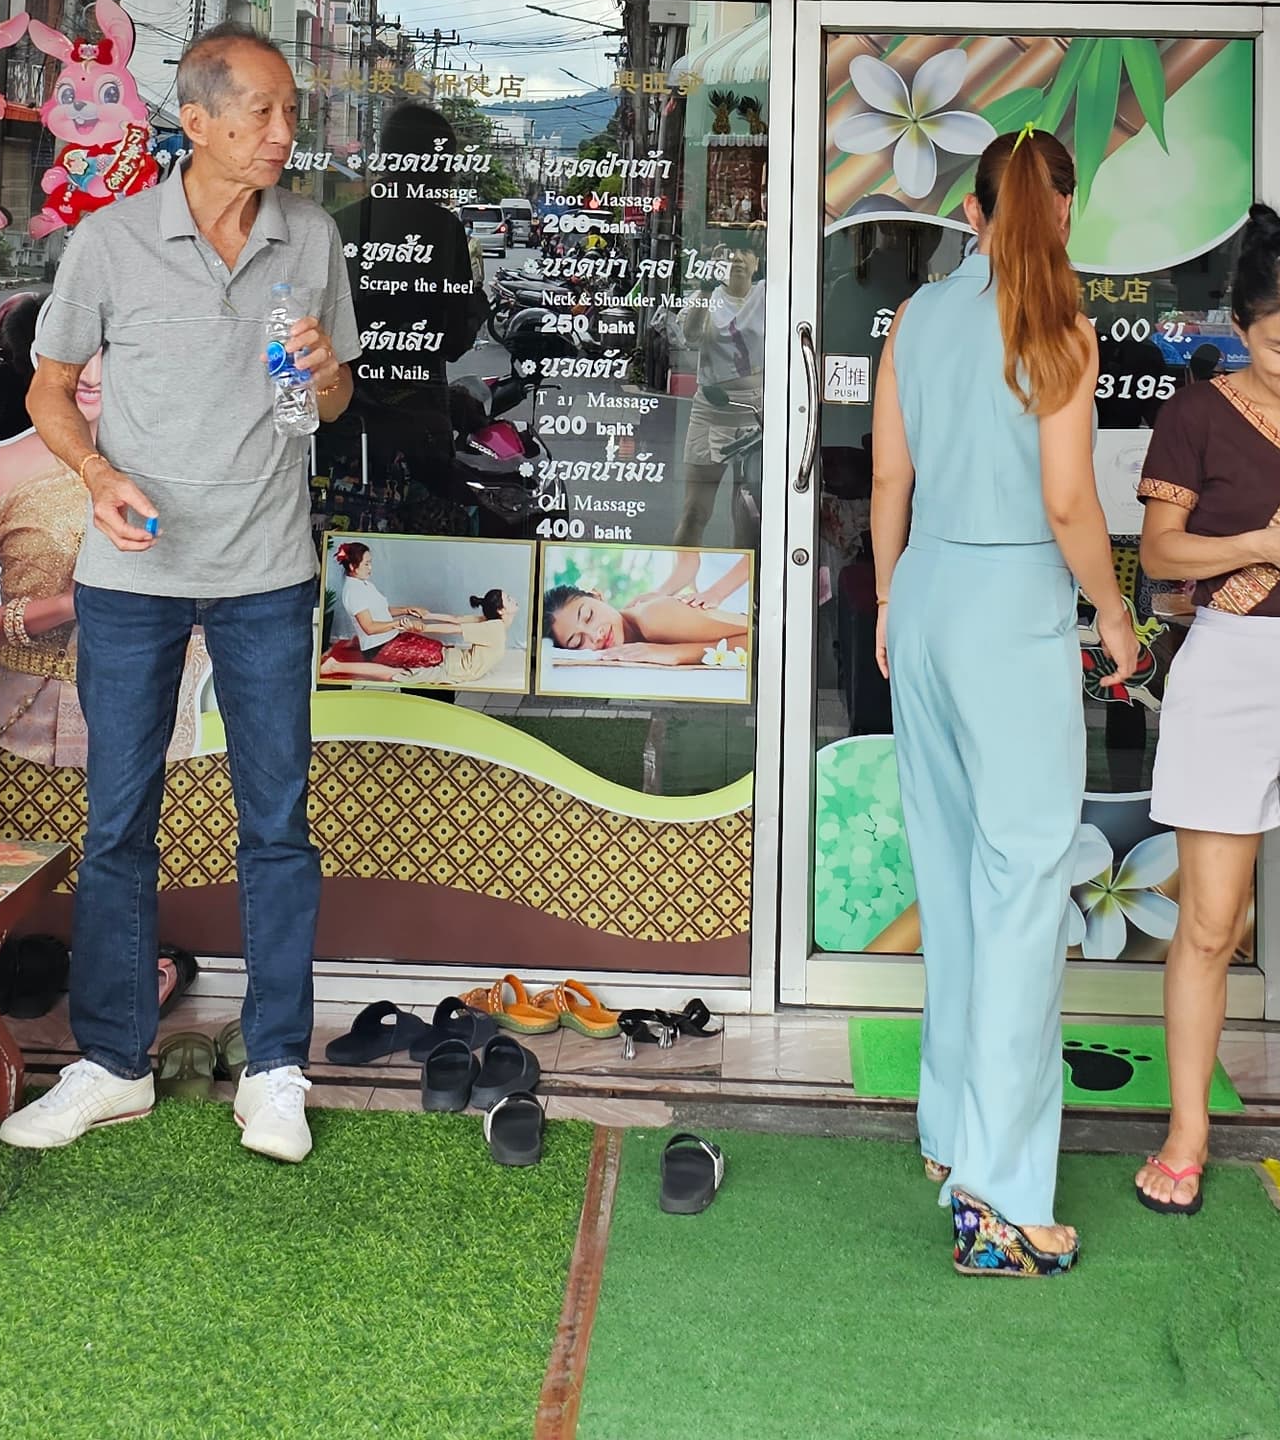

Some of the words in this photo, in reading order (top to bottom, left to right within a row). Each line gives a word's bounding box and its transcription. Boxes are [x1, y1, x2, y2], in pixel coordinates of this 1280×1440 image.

[367, 138, 491, 173] นวดน้ำมัน
[544, 150, 672, 179] นวดฝ่าเท้า
[370, 182, 398, 199] Oil
[407, 183, 478, 204] Massage
[544, 190, 583, 207] Foot
[591, 191, 662, 213] Massage
[600, 220, 637, 234] baht
[360, 234, 434, 270] ขูดส้น
[541, 248, 628, 278] นวดบ่า
[636, 259, 675, 278] คอ
[683, 248, 734, 281] ไหล่
[360, 276, 408, 295] Scrape
[415, 278, 437, 293] the
[443, 278, 474, 295] heel
[541, 290, 577, 306] Neck
[578, 292, 592, 306] &
[594, 292, 656, 307] Shoulder
[541, 314, 589, 333] 250
[598, 320, 635, 334] baht
[360, 319, 444, 352] ตัดเล็บ
[357, 364, 385, 379] Cut
[390, 365, 430, 381] Nails
[540, 349, 630, 378] นวดตัว
[848, 367, 866, 386] 推
[587, 392, 659, 413] Massage
[834, 389, 859, 398] PUSH
[539, 415, 587, 434] 200
[596, 422, 634, 436] baht
[538, 444, 665, 481] นวดน้ำมัน
[538, 494, 566, 511] Oil
[574, 495, 645, 517] Massage
[536, 518, 585, 538] 400
[594, 525, 632, 540] baht
